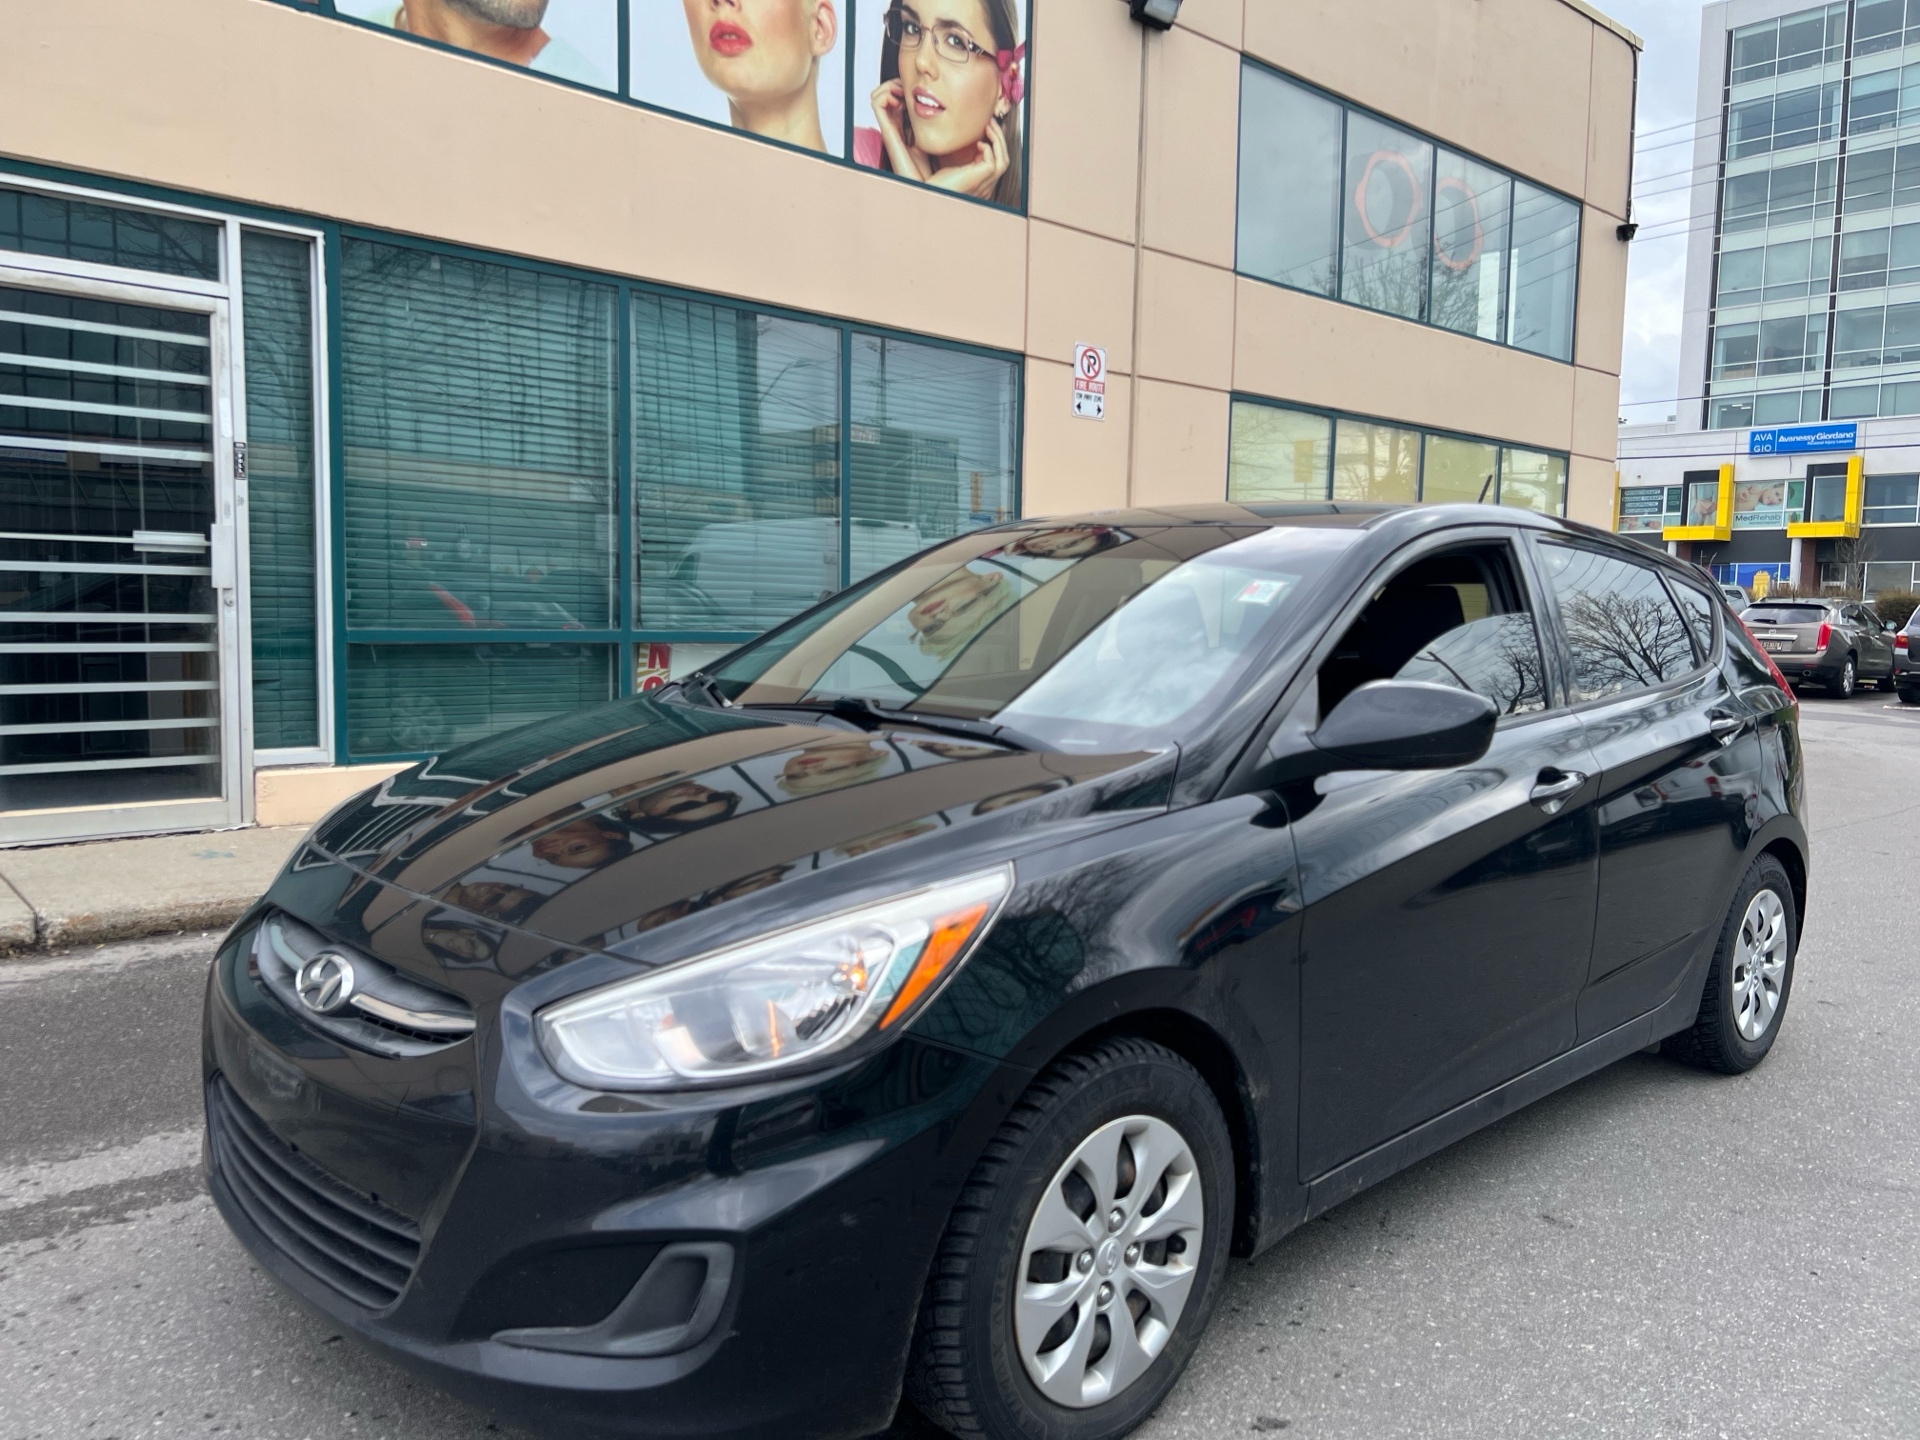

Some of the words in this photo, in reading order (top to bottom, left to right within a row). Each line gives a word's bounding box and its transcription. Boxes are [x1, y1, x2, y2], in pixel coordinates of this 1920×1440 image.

[1077, 380, 1087, 391] FIRE
[1089, 382, 1103, 394] ROUTE
[1754, 433, 1773, 441] AVA
[1754, 444, 1771, 452] GIO
